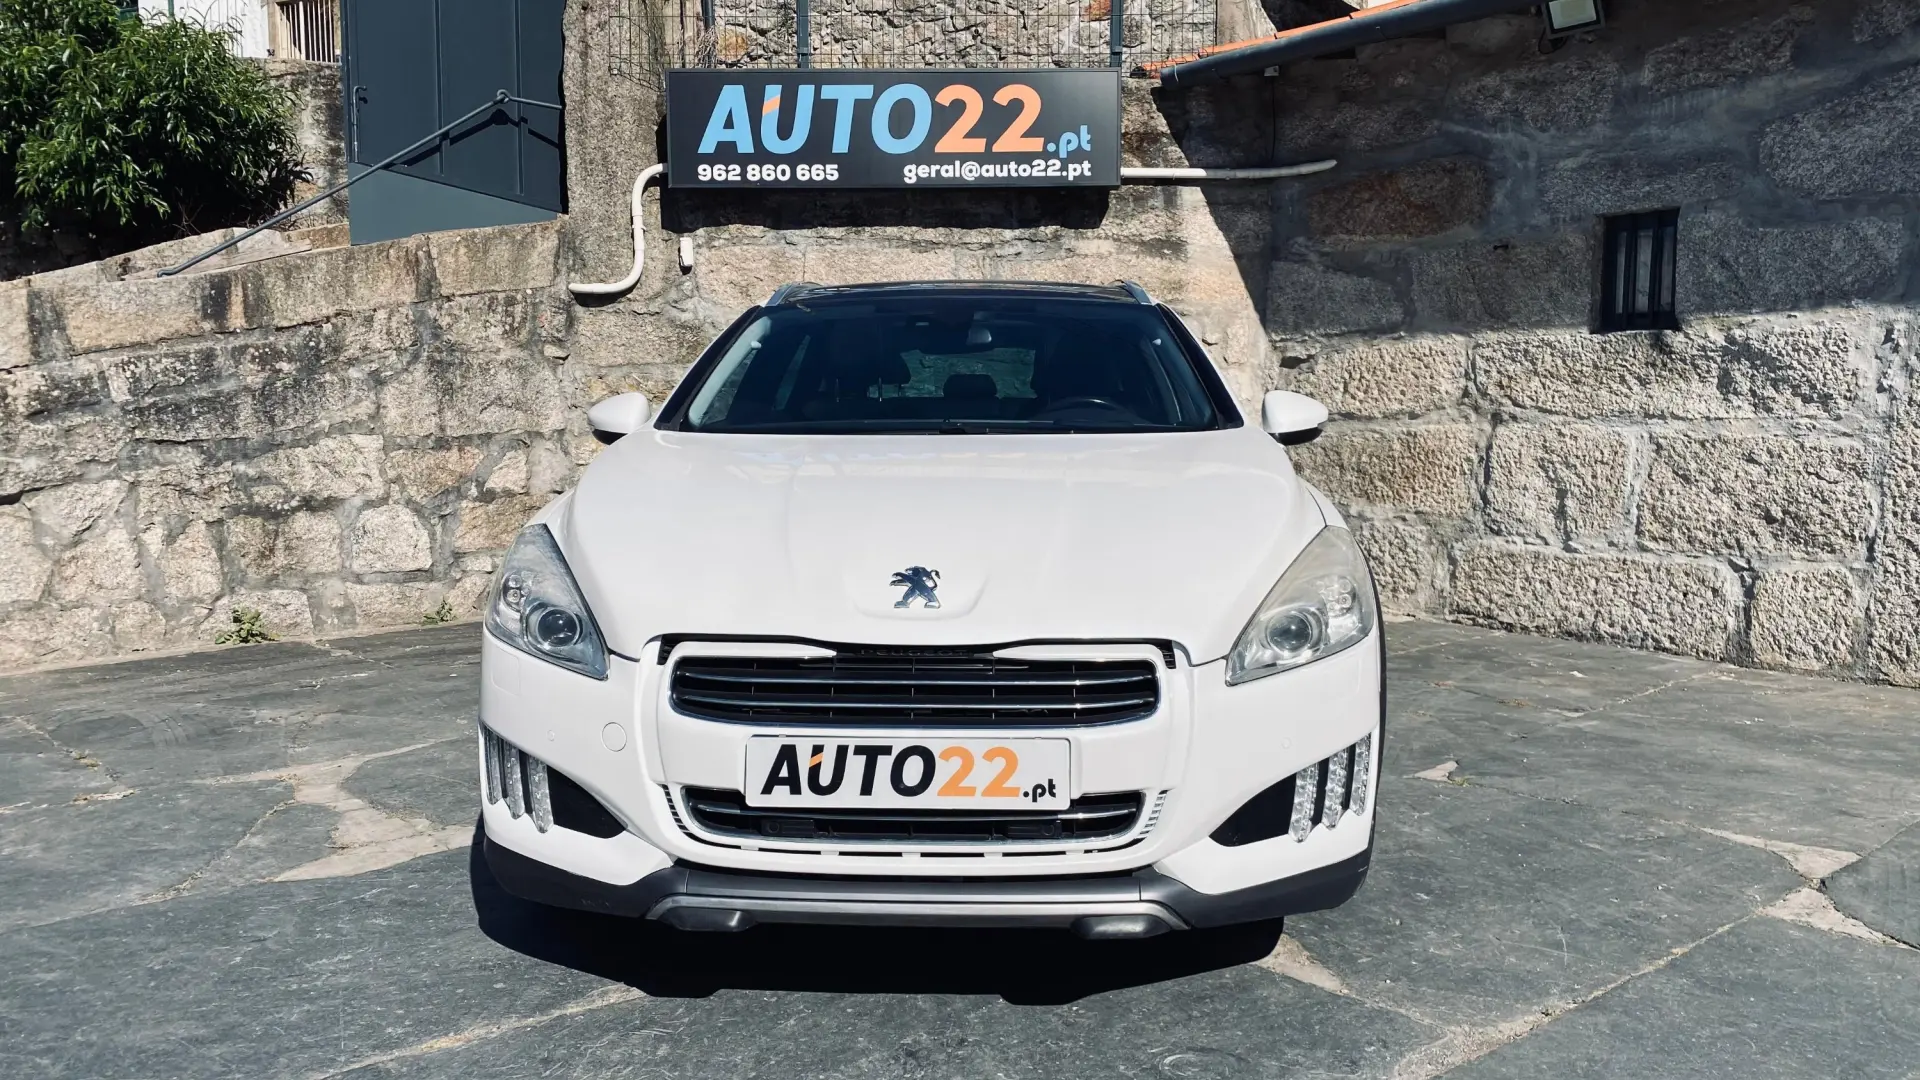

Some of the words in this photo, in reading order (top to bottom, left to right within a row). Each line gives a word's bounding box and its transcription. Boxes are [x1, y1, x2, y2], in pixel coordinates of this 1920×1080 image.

[697, 83, 1091, 158] AUTO22.pt
[698, 164, 741, 181] 962
[746, 164, 791, 181] 860
[796, 164, 839, 181] 665
[903, 159, 1091, 184] geral@auto22.pt
[760, 744, 1057, 803] AUTO22.pt
